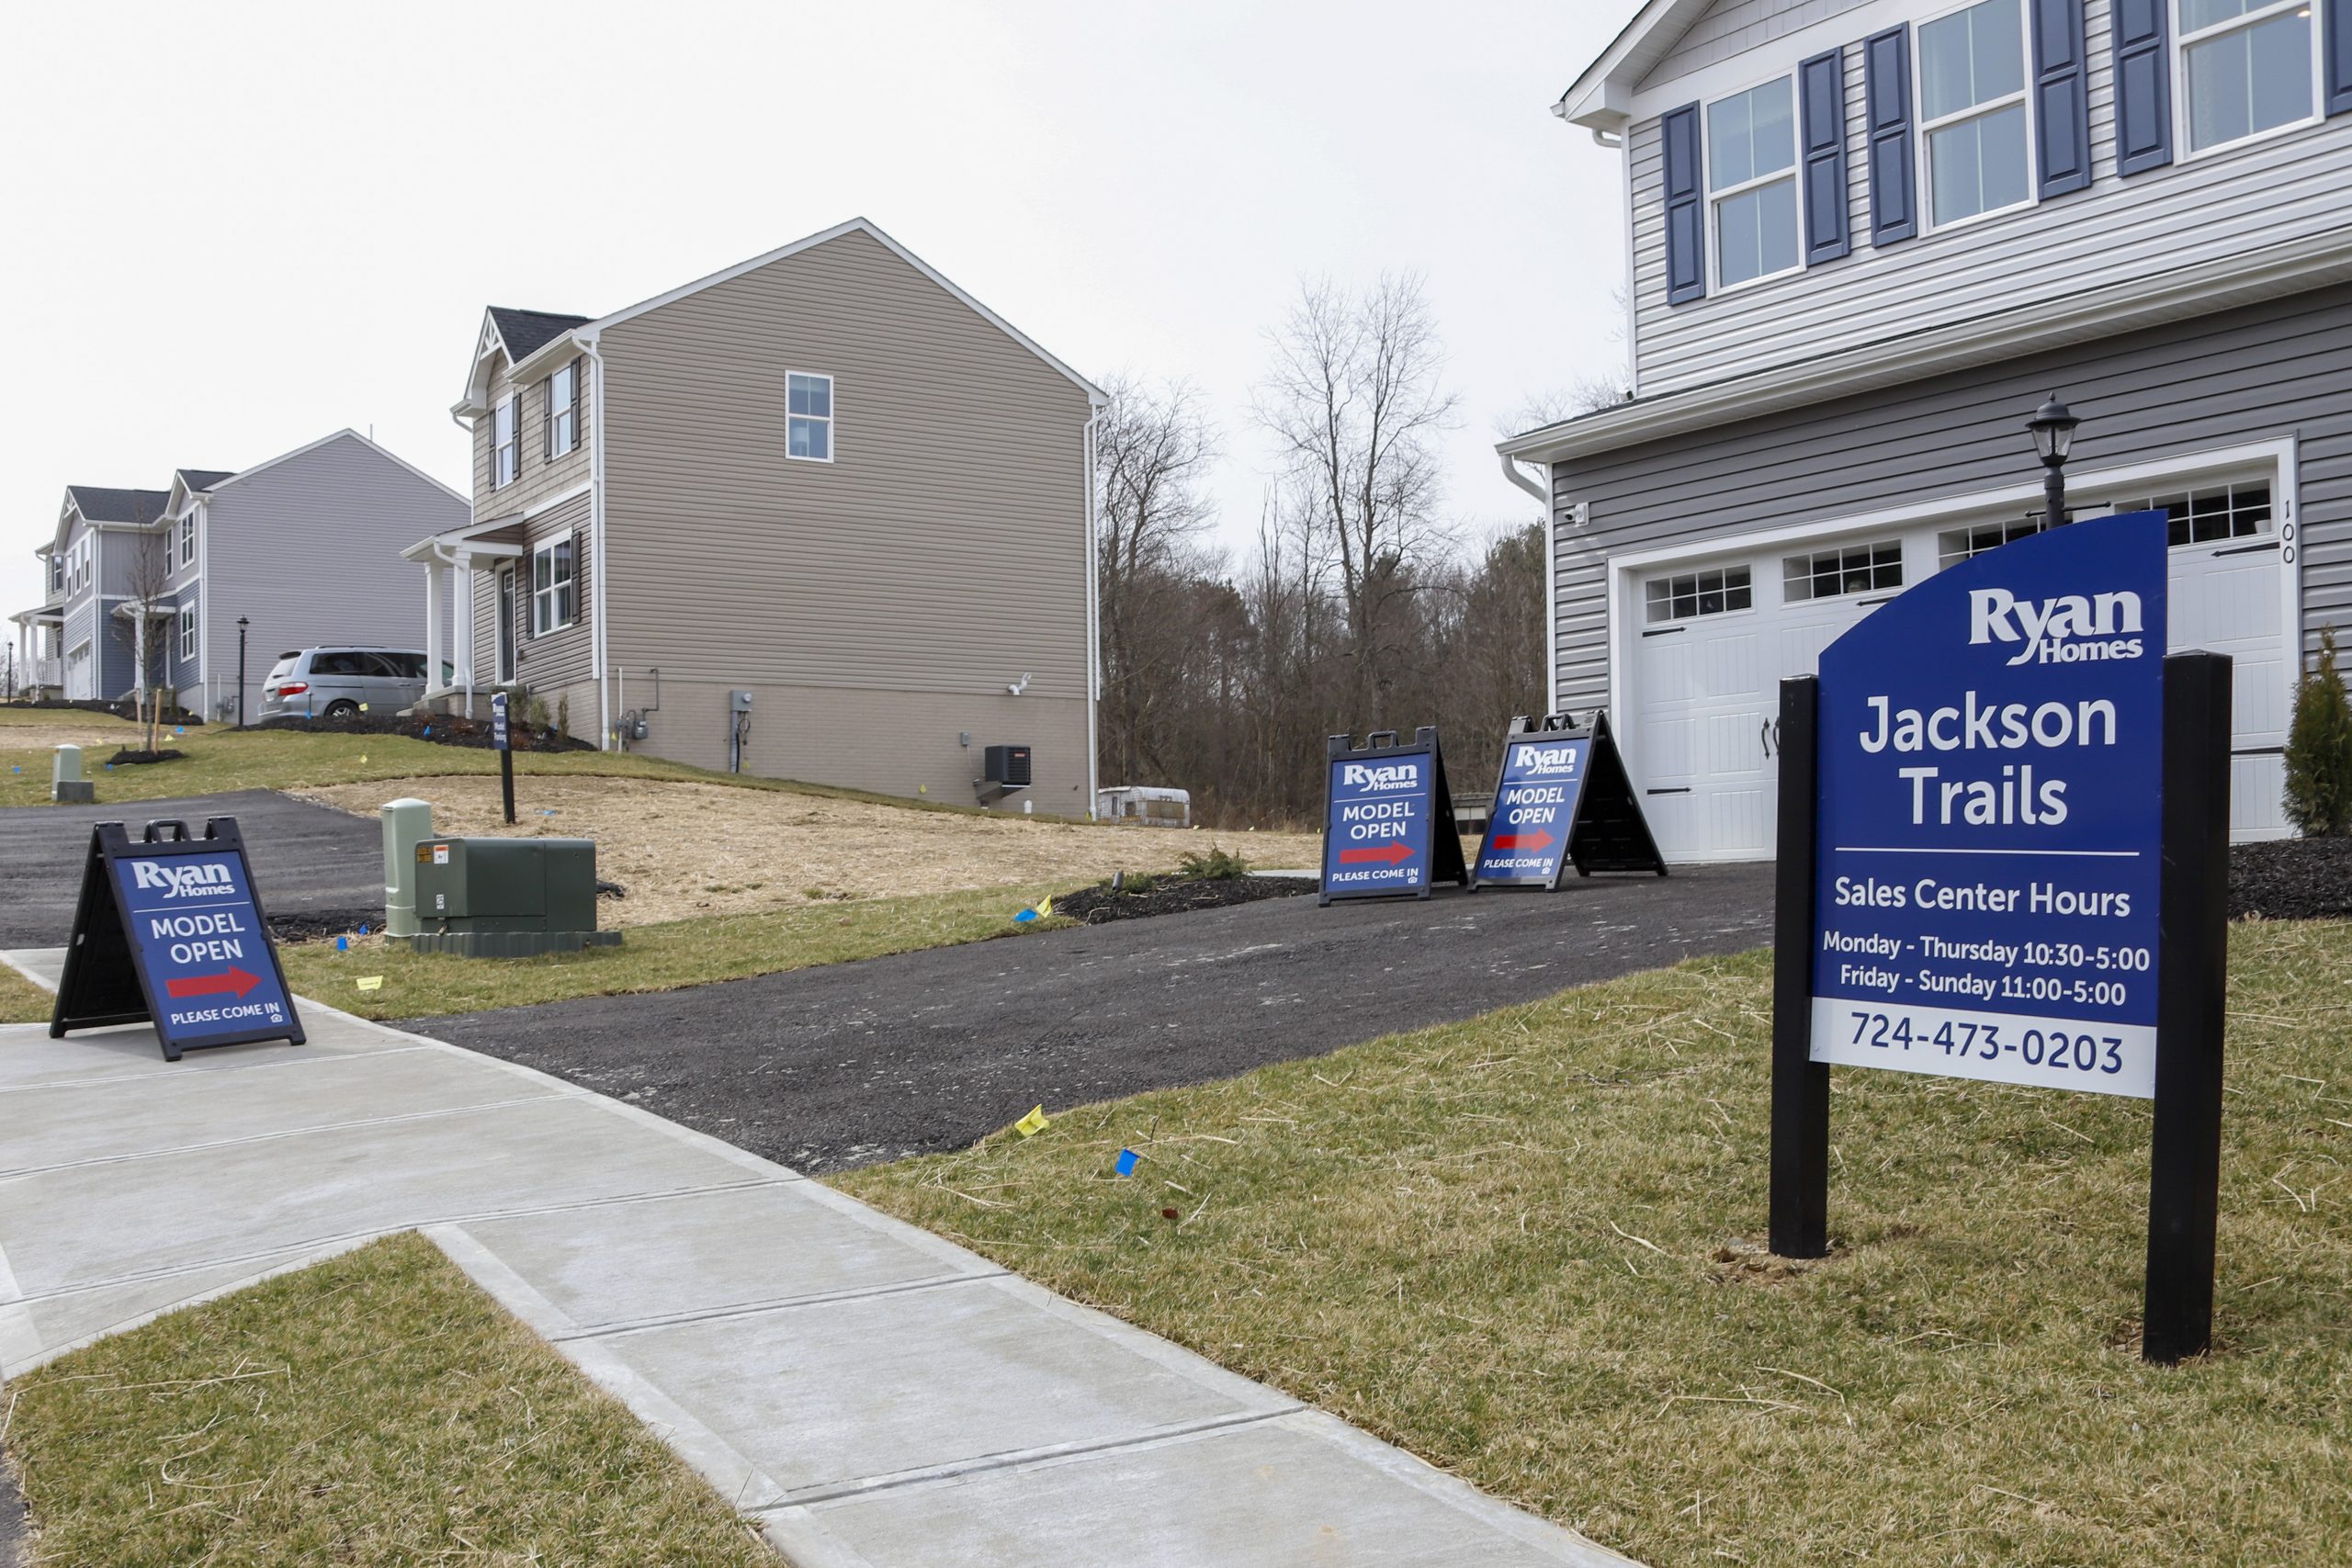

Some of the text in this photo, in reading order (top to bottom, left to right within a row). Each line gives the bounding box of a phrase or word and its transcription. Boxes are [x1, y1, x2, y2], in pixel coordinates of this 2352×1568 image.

[2282, 500, 2295, 564] 100
[1968, 588, 2144, 666] Ryan
[2039, 638, 2143, 664] Homes
[1860, 691, 2117, 753] Jackson
[1514, 746, 1577, 775] Ryan
[1537, 764, 1574, 775] Homes
[1343, 764, 1418, 792] Ryan
[1374, 780, 1419, 791] Homes
[1506, 787, 1566, 806] MODEL
[1898, 764, 2068, 826] Trails
[1342, 802, 1415, 822] MODEL
[1509, 807, 1555, 825] OPEN
[1350, 821, 1407, 840] OPEN
[1332, 867, 1419, 882] PLEASE COME IN
[1483, 858, 1554, 868] PLEASE COME IN
[130, 861, 232, 898] Ryan
[179, 884, 236, 897] Homes
[1835, 876, 2131, 918] Sales Center Hours
[151, 913, 245, 940] MODEL
[170, 939, 243, 964] OPEN
[1823, 931, 1902, 960] Monday
[1919, 935, 2019, 967] Thursday
[2023, 942, 2151, 972] 10:30-5:00
[1840, 964, 1900, 993] Friday
[1918, 969, 1996, 1001] Sunday
[2001, 976, 2126, 1007] 11:00-5:00
[171, 1002, 280, 1025] PLEASE COME IN
[1850, 1011, 2123, 1075] 724-473-0203
